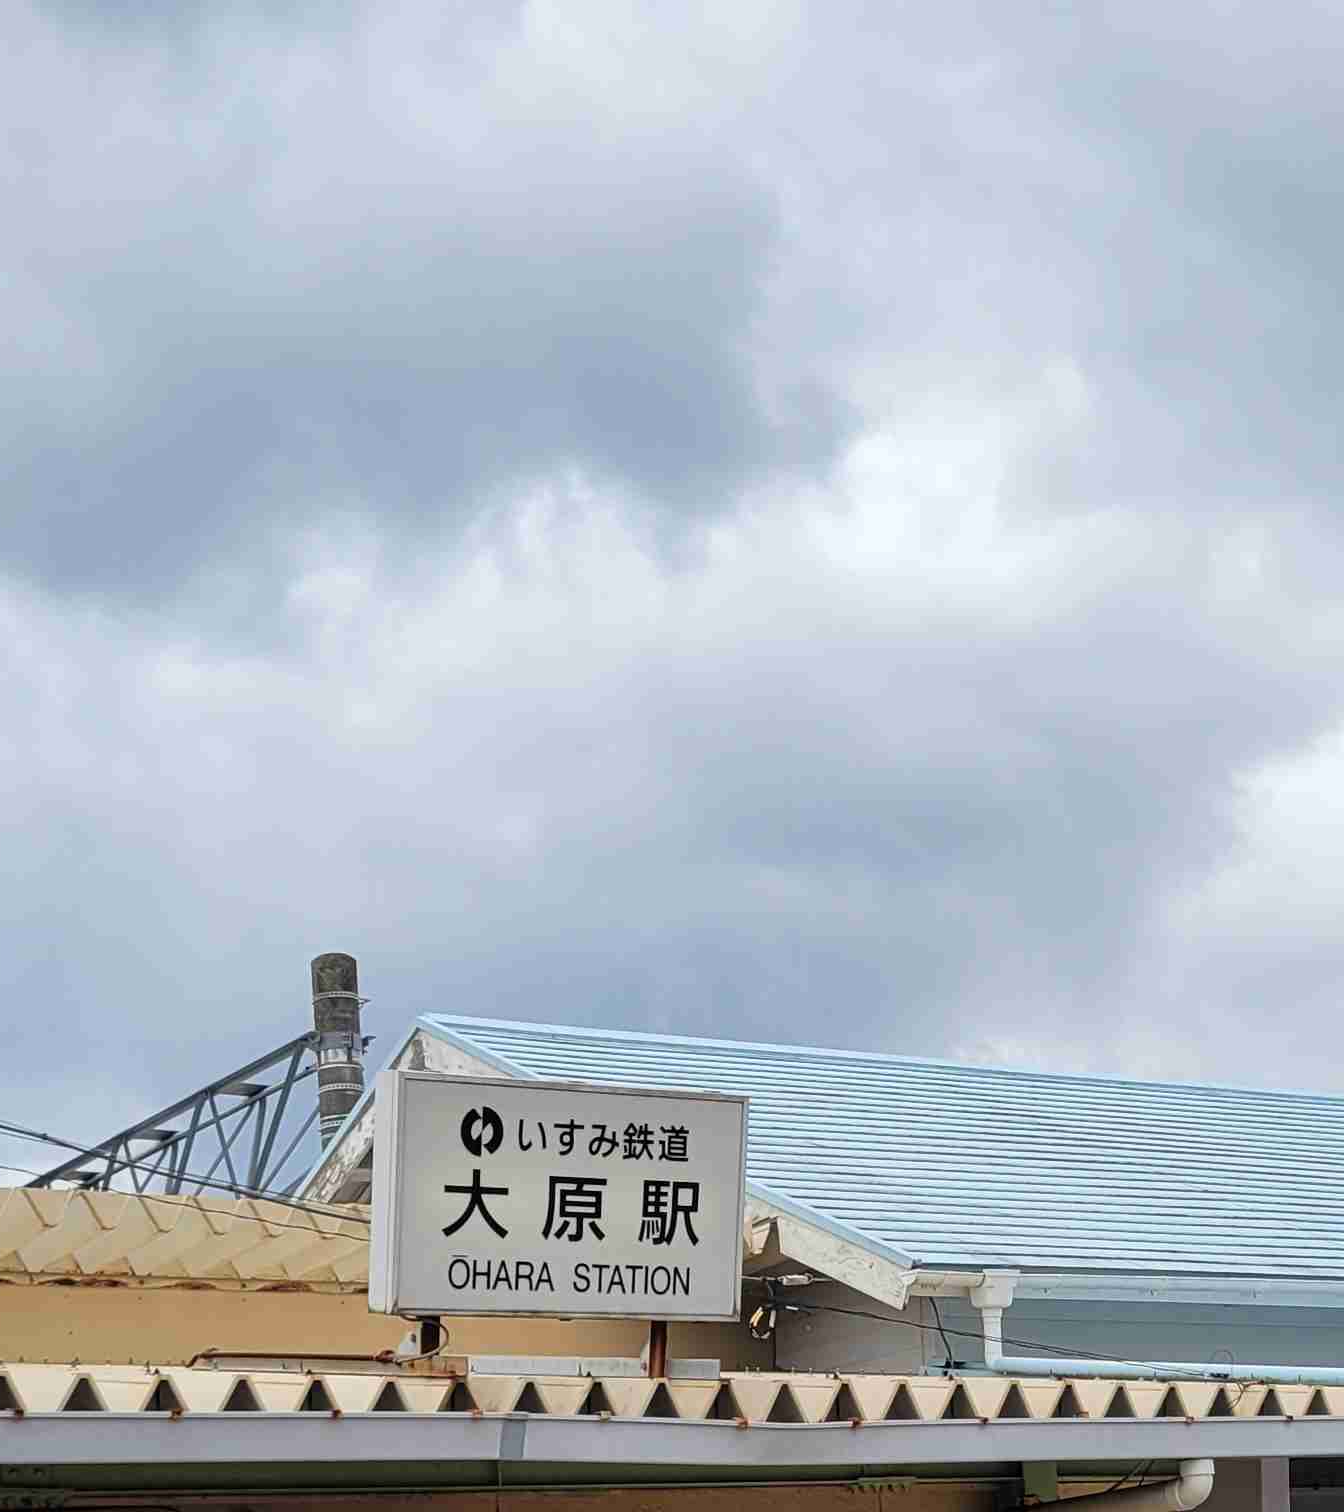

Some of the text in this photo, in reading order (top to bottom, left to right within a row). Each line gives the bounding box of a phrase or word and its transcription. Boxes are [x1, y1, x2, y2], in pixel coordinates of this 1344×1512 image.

[518, 1119, 690, 1162] いすみ鉄道
[442, 1169, 699, 1246] 大原駅
[572, 1263, 691, 1296] STATION
